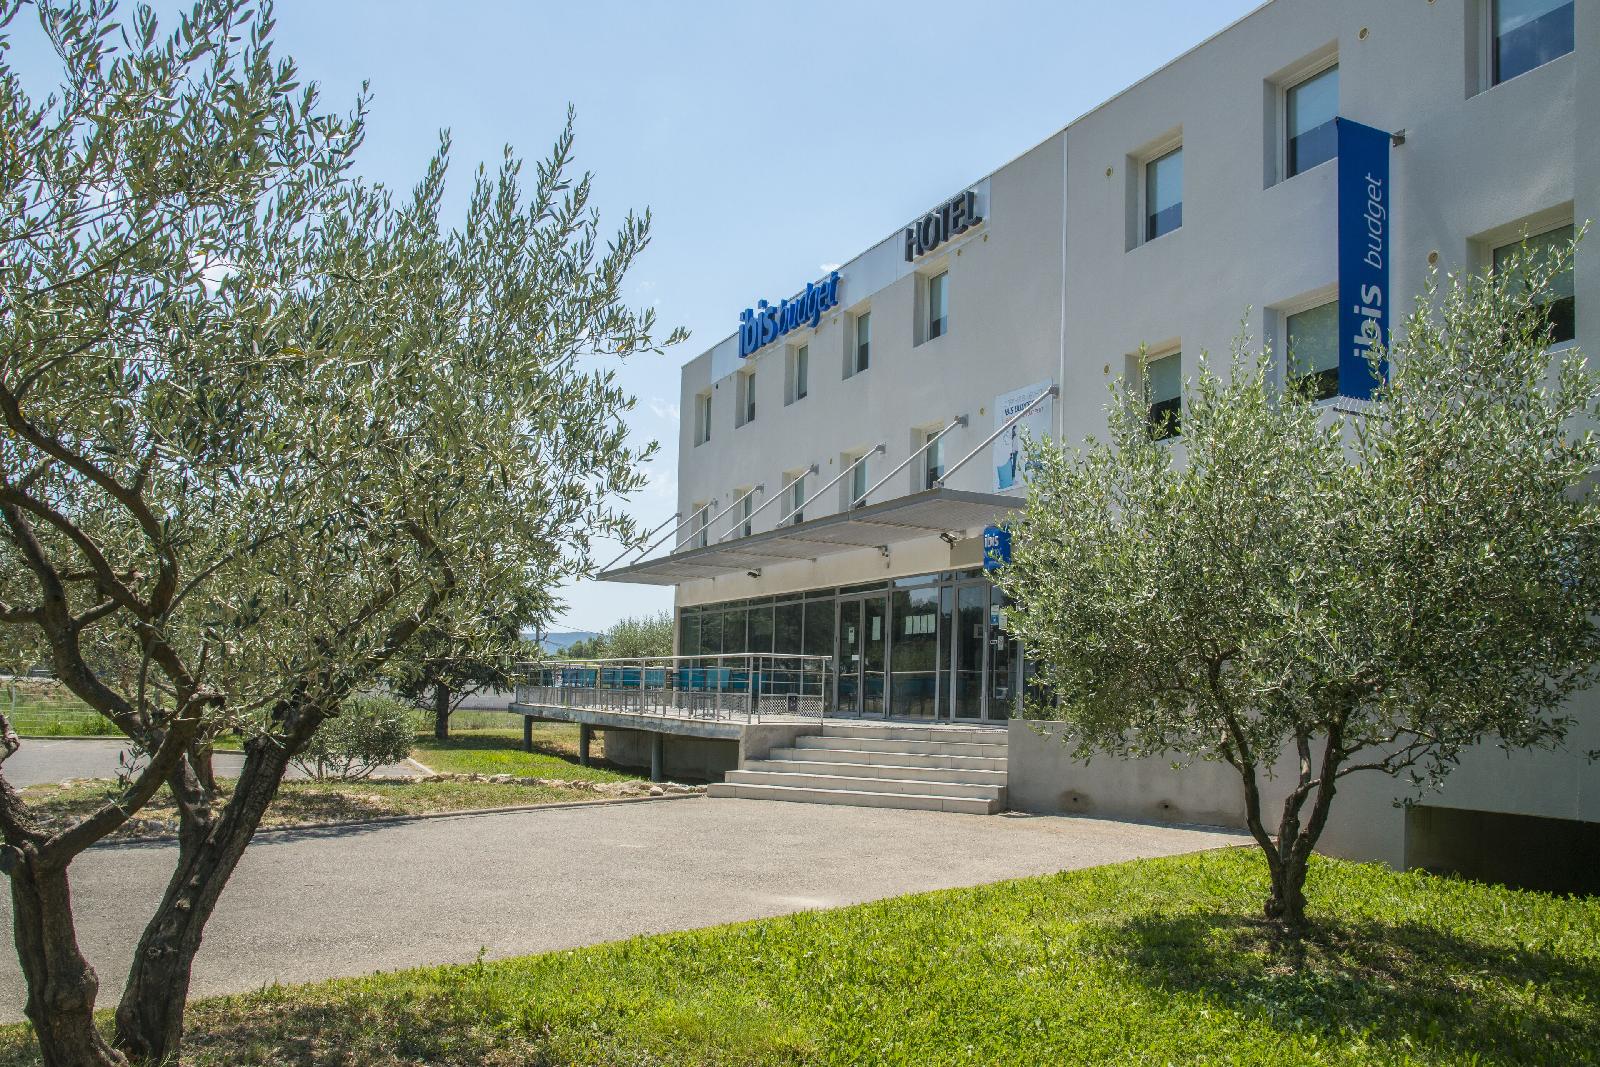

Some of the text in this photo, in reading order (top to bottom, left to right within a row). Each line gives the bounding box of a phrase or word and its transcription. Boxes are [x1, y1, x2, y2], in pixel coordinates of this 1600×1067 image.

[905, 191, 983, 262] HOTEL
[1363, 172, 1387, 269] budget
[739, 271, 841, 358] ibis budget
[984, 533, 999, 548] ibis
